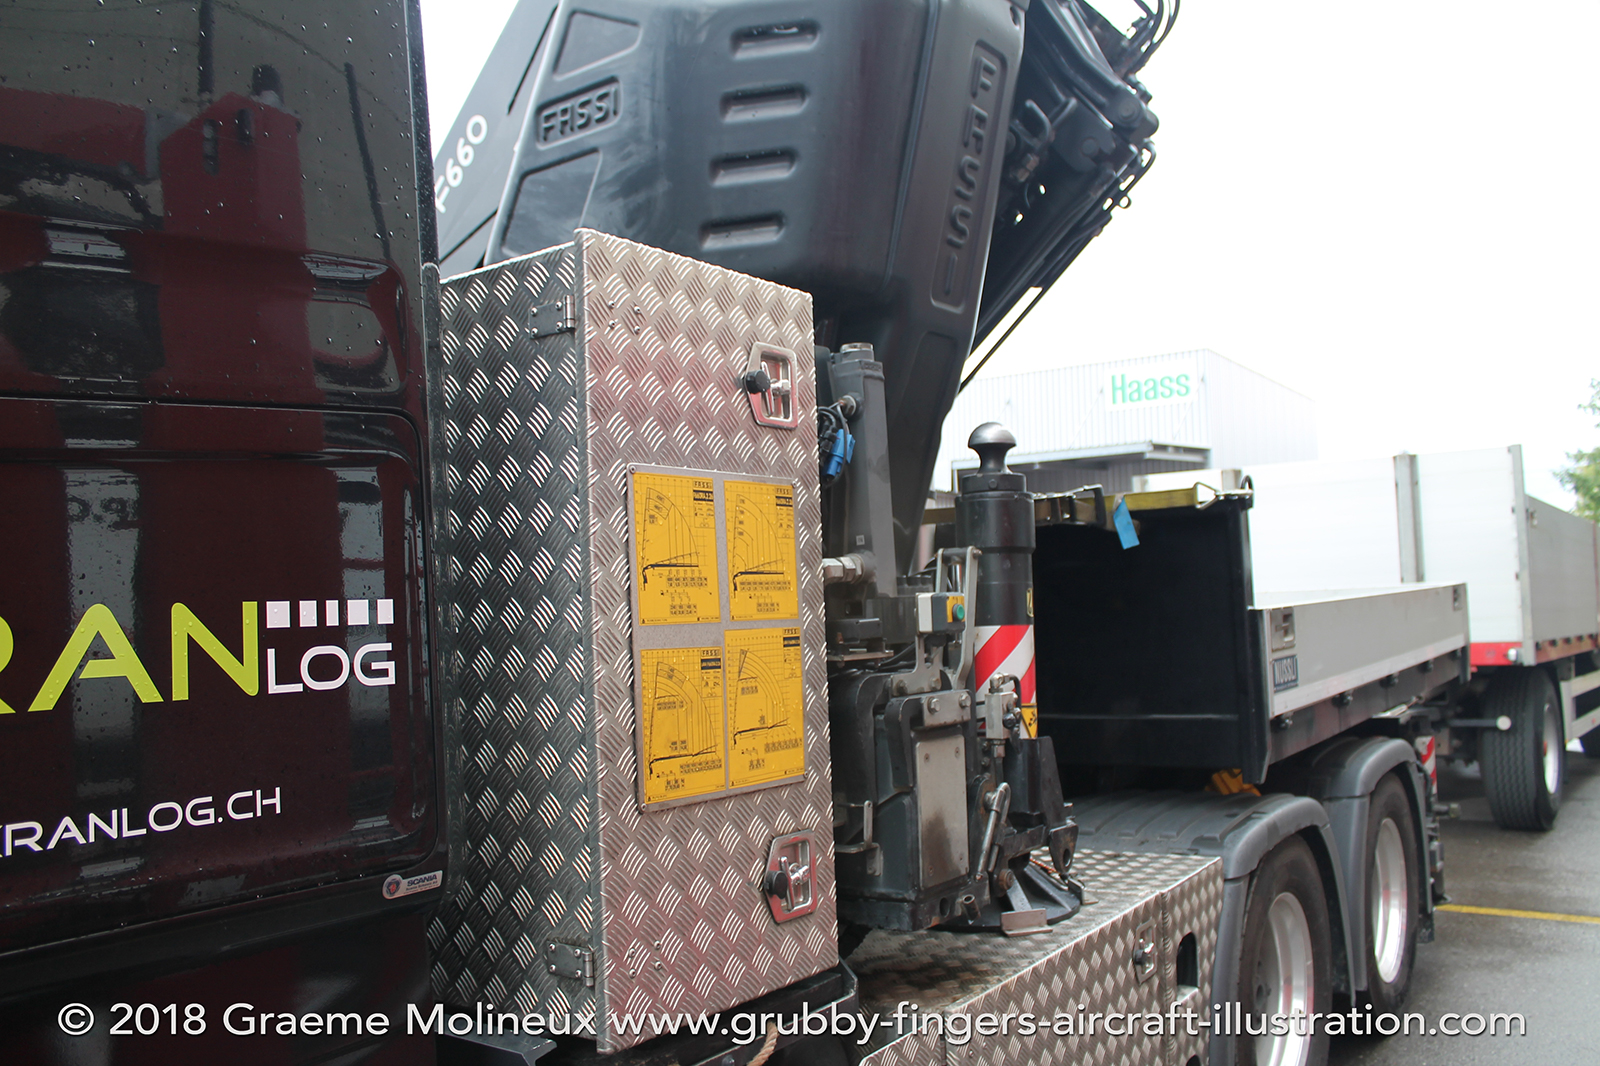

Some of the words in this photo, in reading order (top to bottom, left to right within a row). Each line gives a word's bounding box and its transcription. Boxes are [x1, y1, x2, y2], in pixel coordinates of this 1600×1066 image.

[541, 86, 618, 142] FASSI
[942, 56, 998, 296] FASSI
[1111, 373, 1192, 405] Haass
[0, 600, 260, 715] AN
[267, 642, 397, 695] LOG
[0, 786, 282, 858] RANLOG.CH
[407, 874, 438, 887] SCANIA
